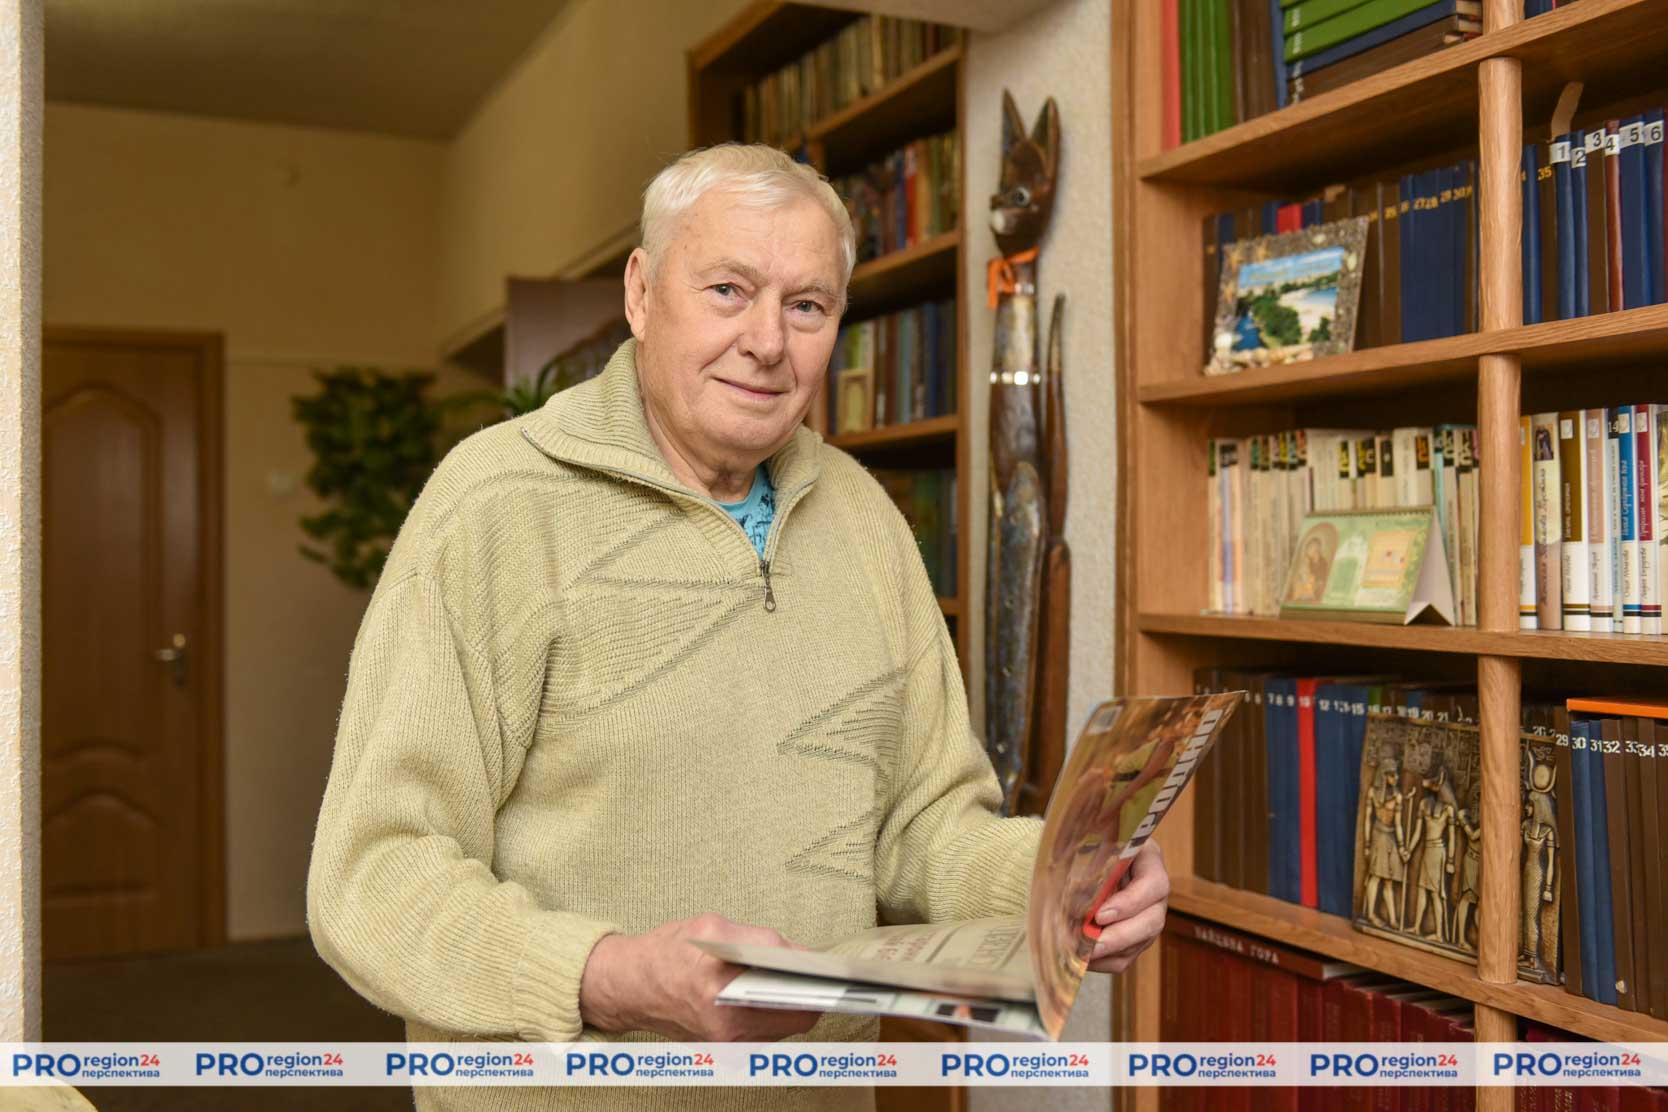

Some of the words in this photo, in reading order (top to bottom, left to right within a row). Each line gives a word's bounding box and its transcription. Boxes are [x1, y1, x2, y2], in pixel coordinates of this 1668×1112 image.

[1592, 132, 1602, 147] 3
[1629, 127, 1641, 142] 5
[1650, 126, 1662, 141] 6
[1605, 137, 1615, 151] 4
[1558, 145, 1566, 159] 1
[1575, 149, 1586, 165] 2
[1537, 166, 1552, 181] 35
[1556, 734, 1569, 747] 29
[1572, 737, 1587, 750] 30
[1590, 739, 1603, 752] 31
[1603, 741, 1621, 753] 32
[1638, 744, 1655, 758] 34
[1119, 708, 1224, 859] ГРОДНО
